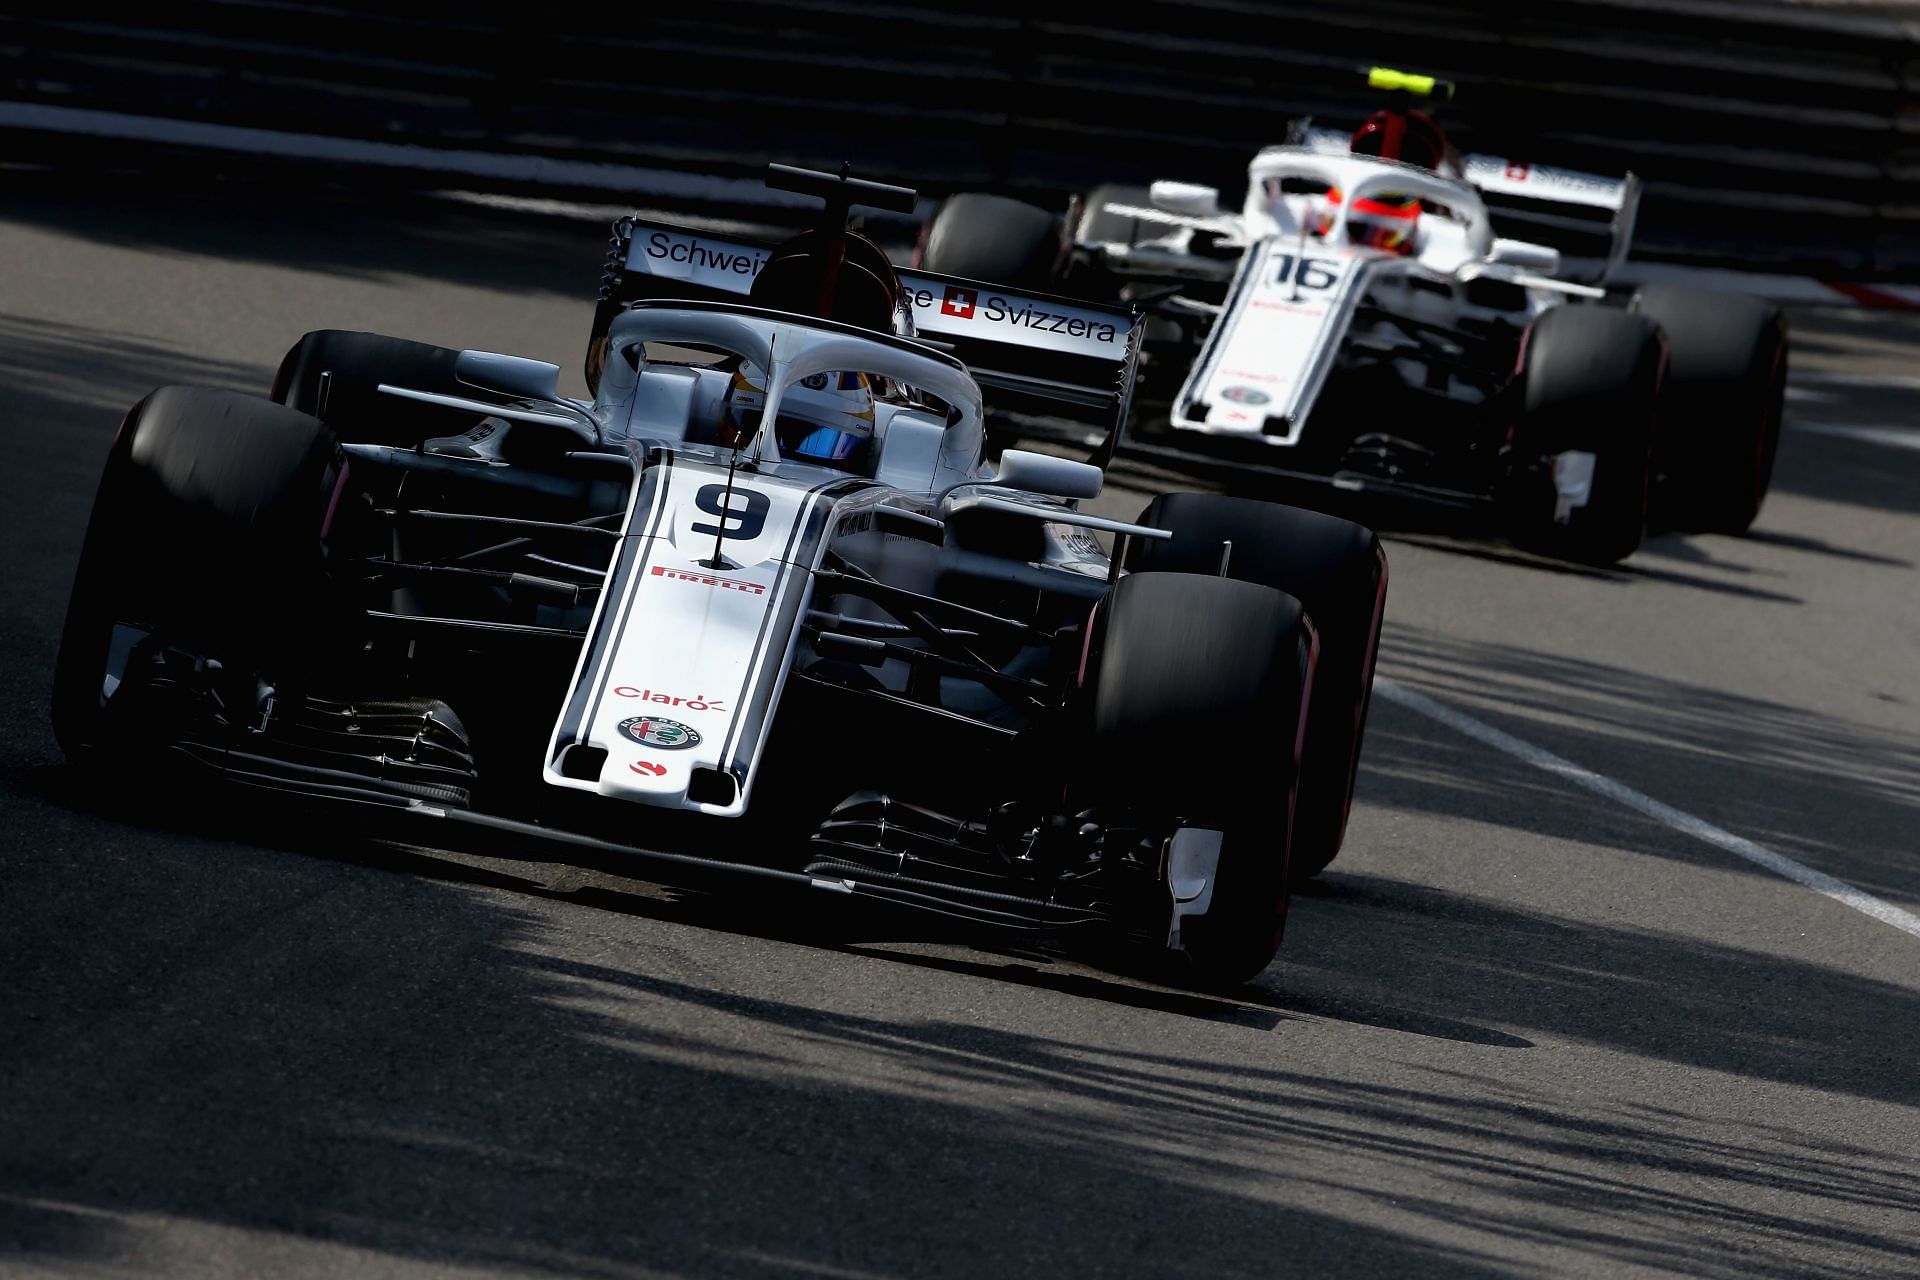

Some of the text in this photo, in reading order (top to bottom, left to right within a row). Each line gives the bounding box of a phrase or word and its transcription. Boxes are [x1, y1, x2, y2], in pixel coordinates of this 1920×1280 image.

[647, 232, 766, 276] Schwei
[984, 296, 1116, 343] Svizzera
[1271, 254, 1338, 290] 16
[691, 484, 771, 541] 9
[651, 566, 766, 595] PIRELLI
[614, 686, 709, 711] Claro
[620, 717, 699, 741] ALFA ROMEO
